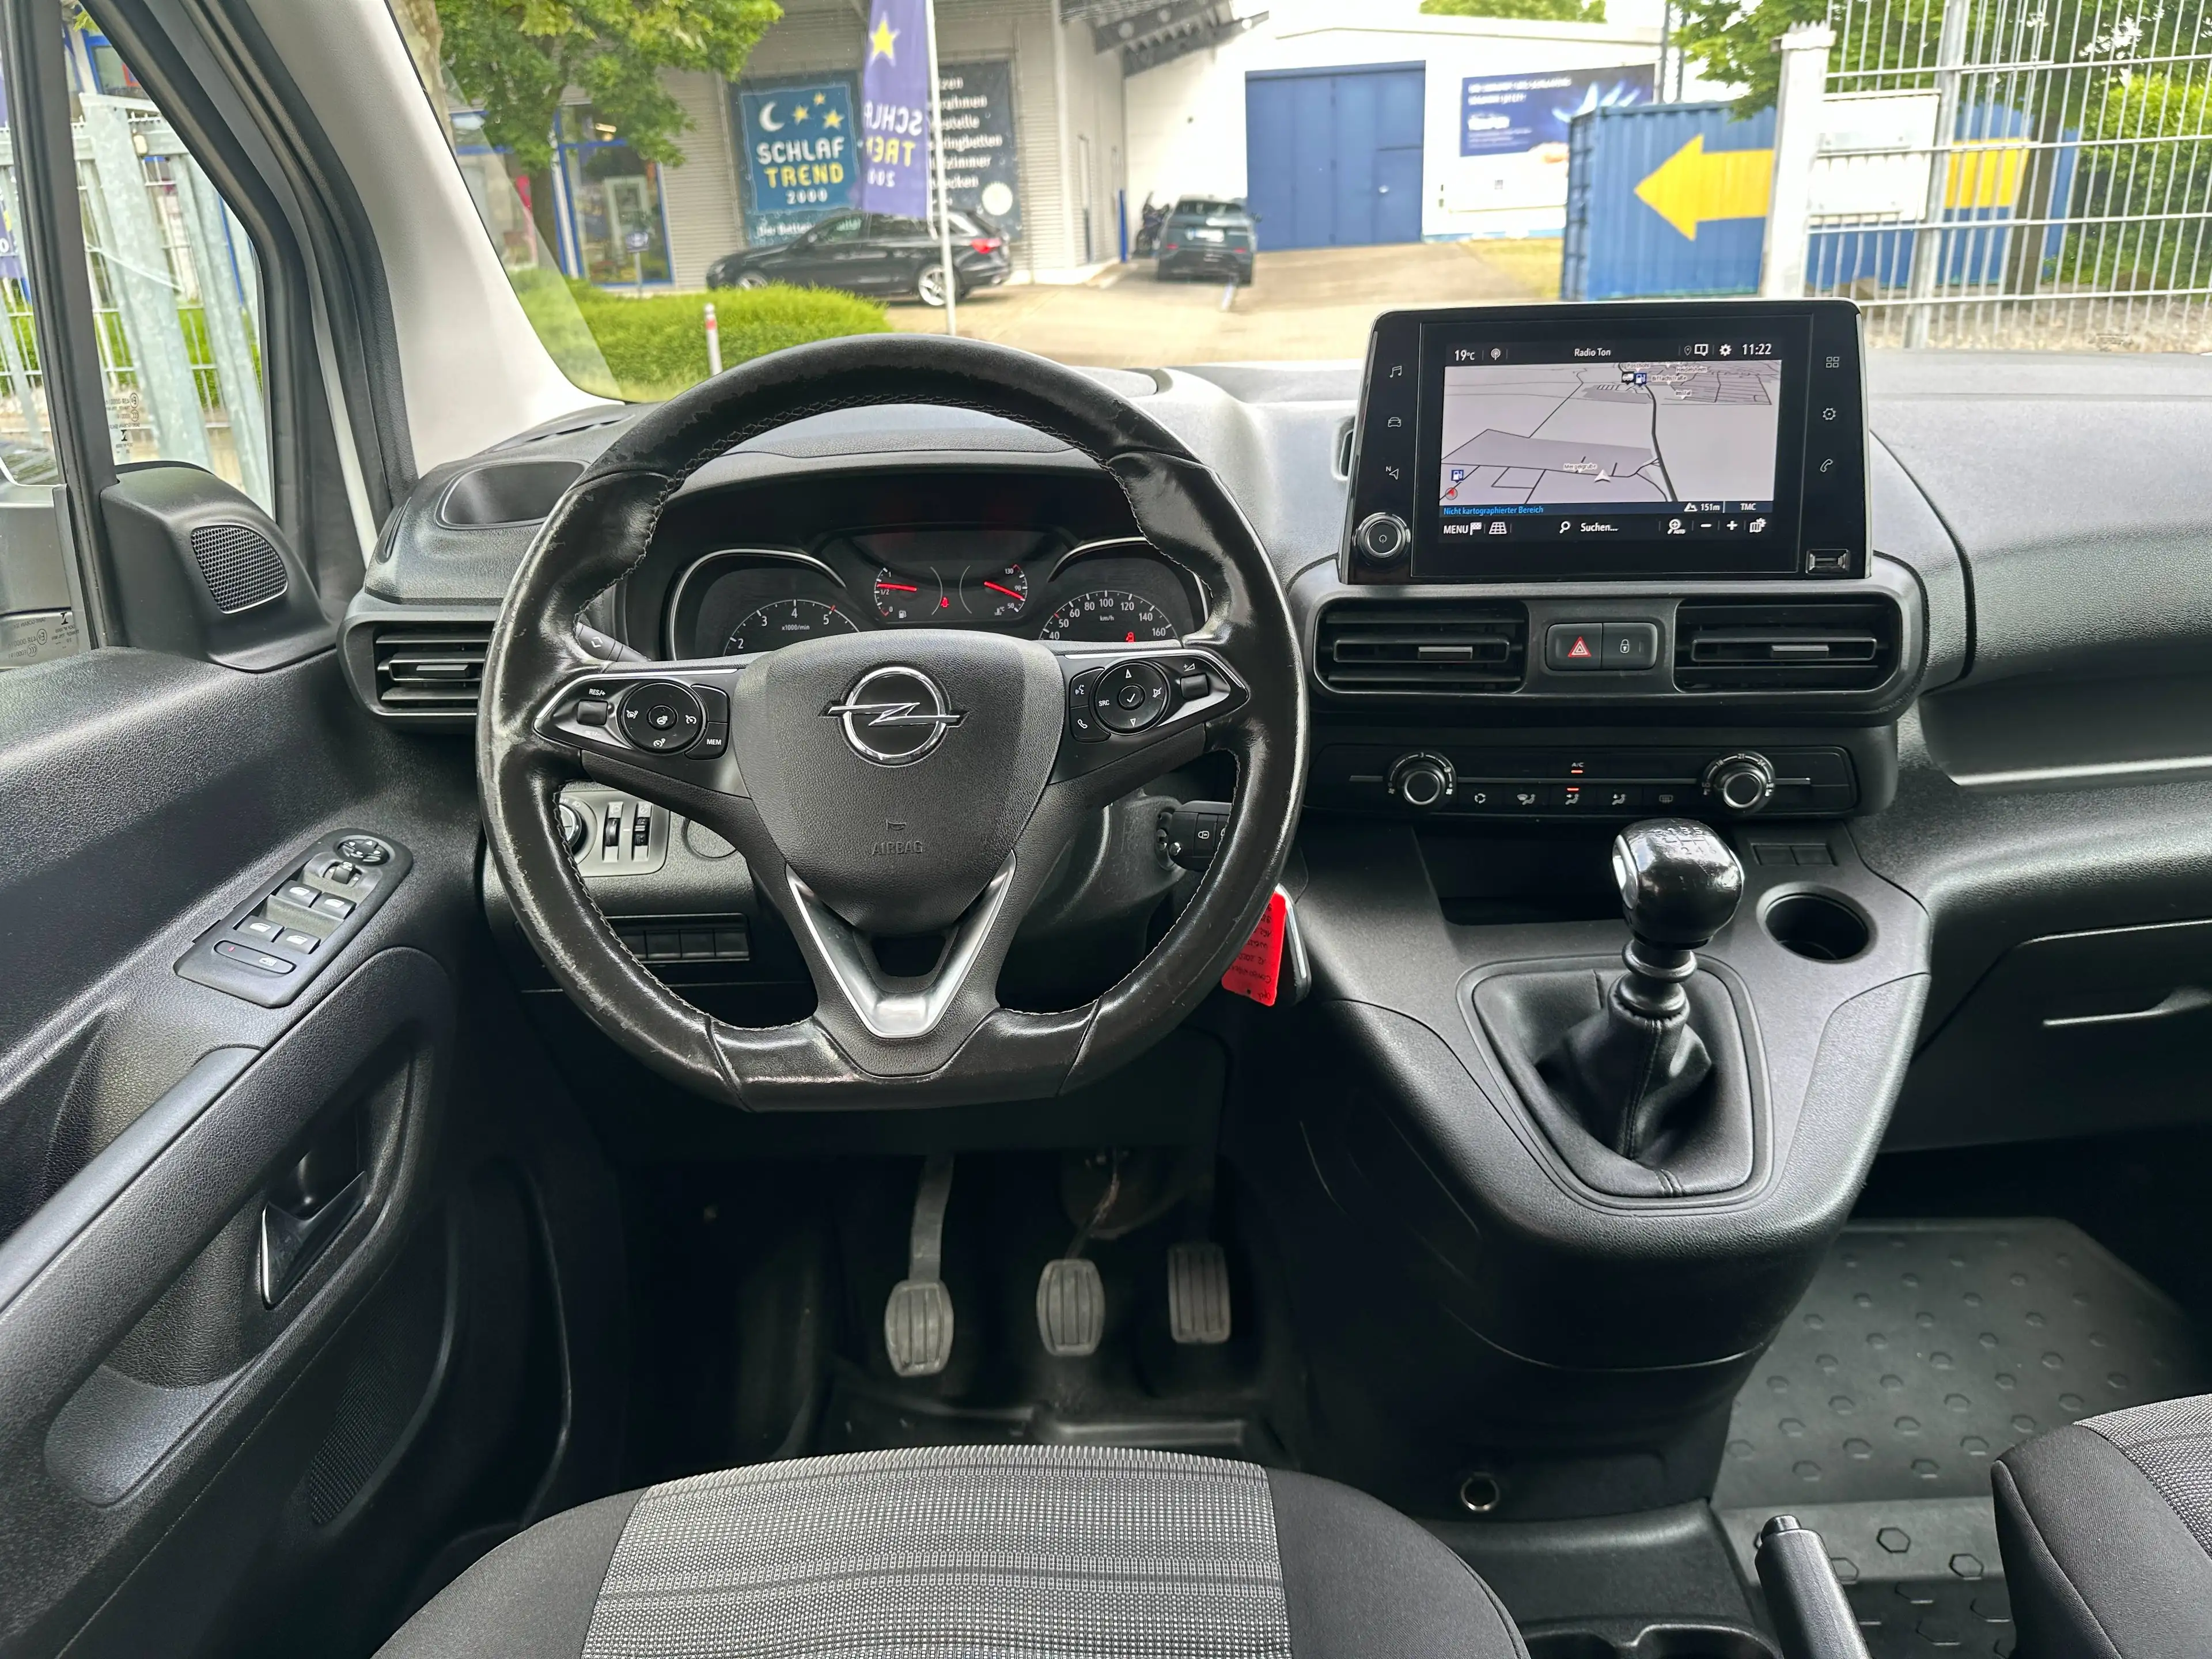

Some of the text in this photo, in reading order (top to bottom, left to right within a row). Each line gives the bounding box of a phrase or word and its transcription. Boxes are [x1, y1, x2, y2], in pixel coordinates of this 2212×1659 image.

[756, 136, 845, 165] SCHLAF
[764, 162, 844, 188] TREND
[786, 188, 828, 204] 2000
[1574, 347, 1611, 357] Radio Ton
[1742, 343, 1772, 355] 11:22
[1455, 349, 1475, 361] 19°C
[1444, 506, 1543, 516] Nicht kartographierter Bereich
[1740, 503, 1756, 511] TMC
[1444, 524, 1469, 534] MENU
[1580, 522, 1619, 532] Suchen...
[1084, 601, 1095, 611] 80
[1099, 598, 1114, 608] 100
[1120, 602, 1135, 611] 120
[791, 608, 798, 618] 4
[1069, 608, 1080, 618] 60
[1139, 612, 1153, 622] 140
[762, 616, 768, 627] 3
[823, 614, 830, 625] 5
[1059, 619, 1069, 628] 50
[1049, 631, 1060, 641] 40
[1152, 627, 1166, 637] 160
[738, 638, 744, 649] 2
[706, 738, 721, 746] MEM
[872, 840, 923, 856] AIRBAG
